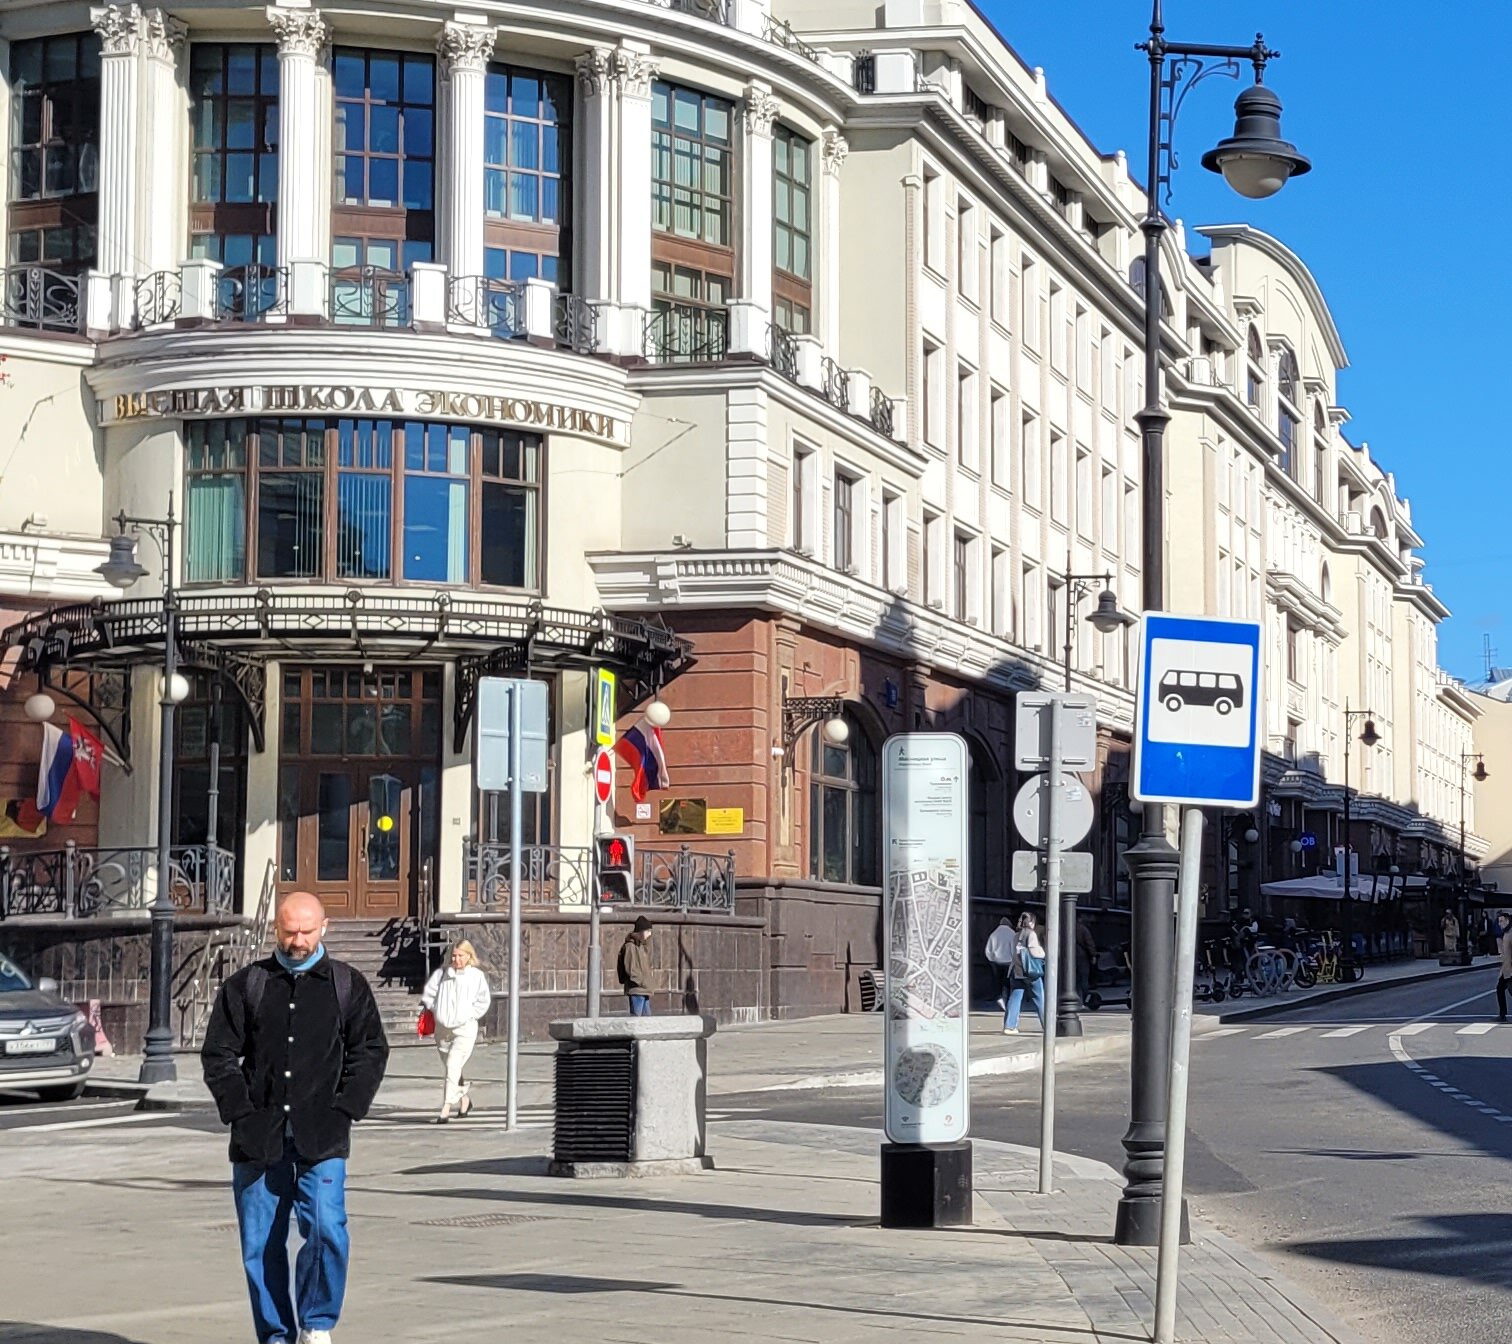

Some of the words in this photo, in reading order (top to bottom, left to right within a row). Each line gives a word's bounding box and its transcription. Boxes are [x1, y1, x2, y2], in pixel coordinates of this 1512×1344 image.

[114, 386, 246, 419] ВЫСШАЯ
[260, 385, 404, 412] ШКОЛА
[414, 390, 616, 439] ЭКОНОМИКИ
